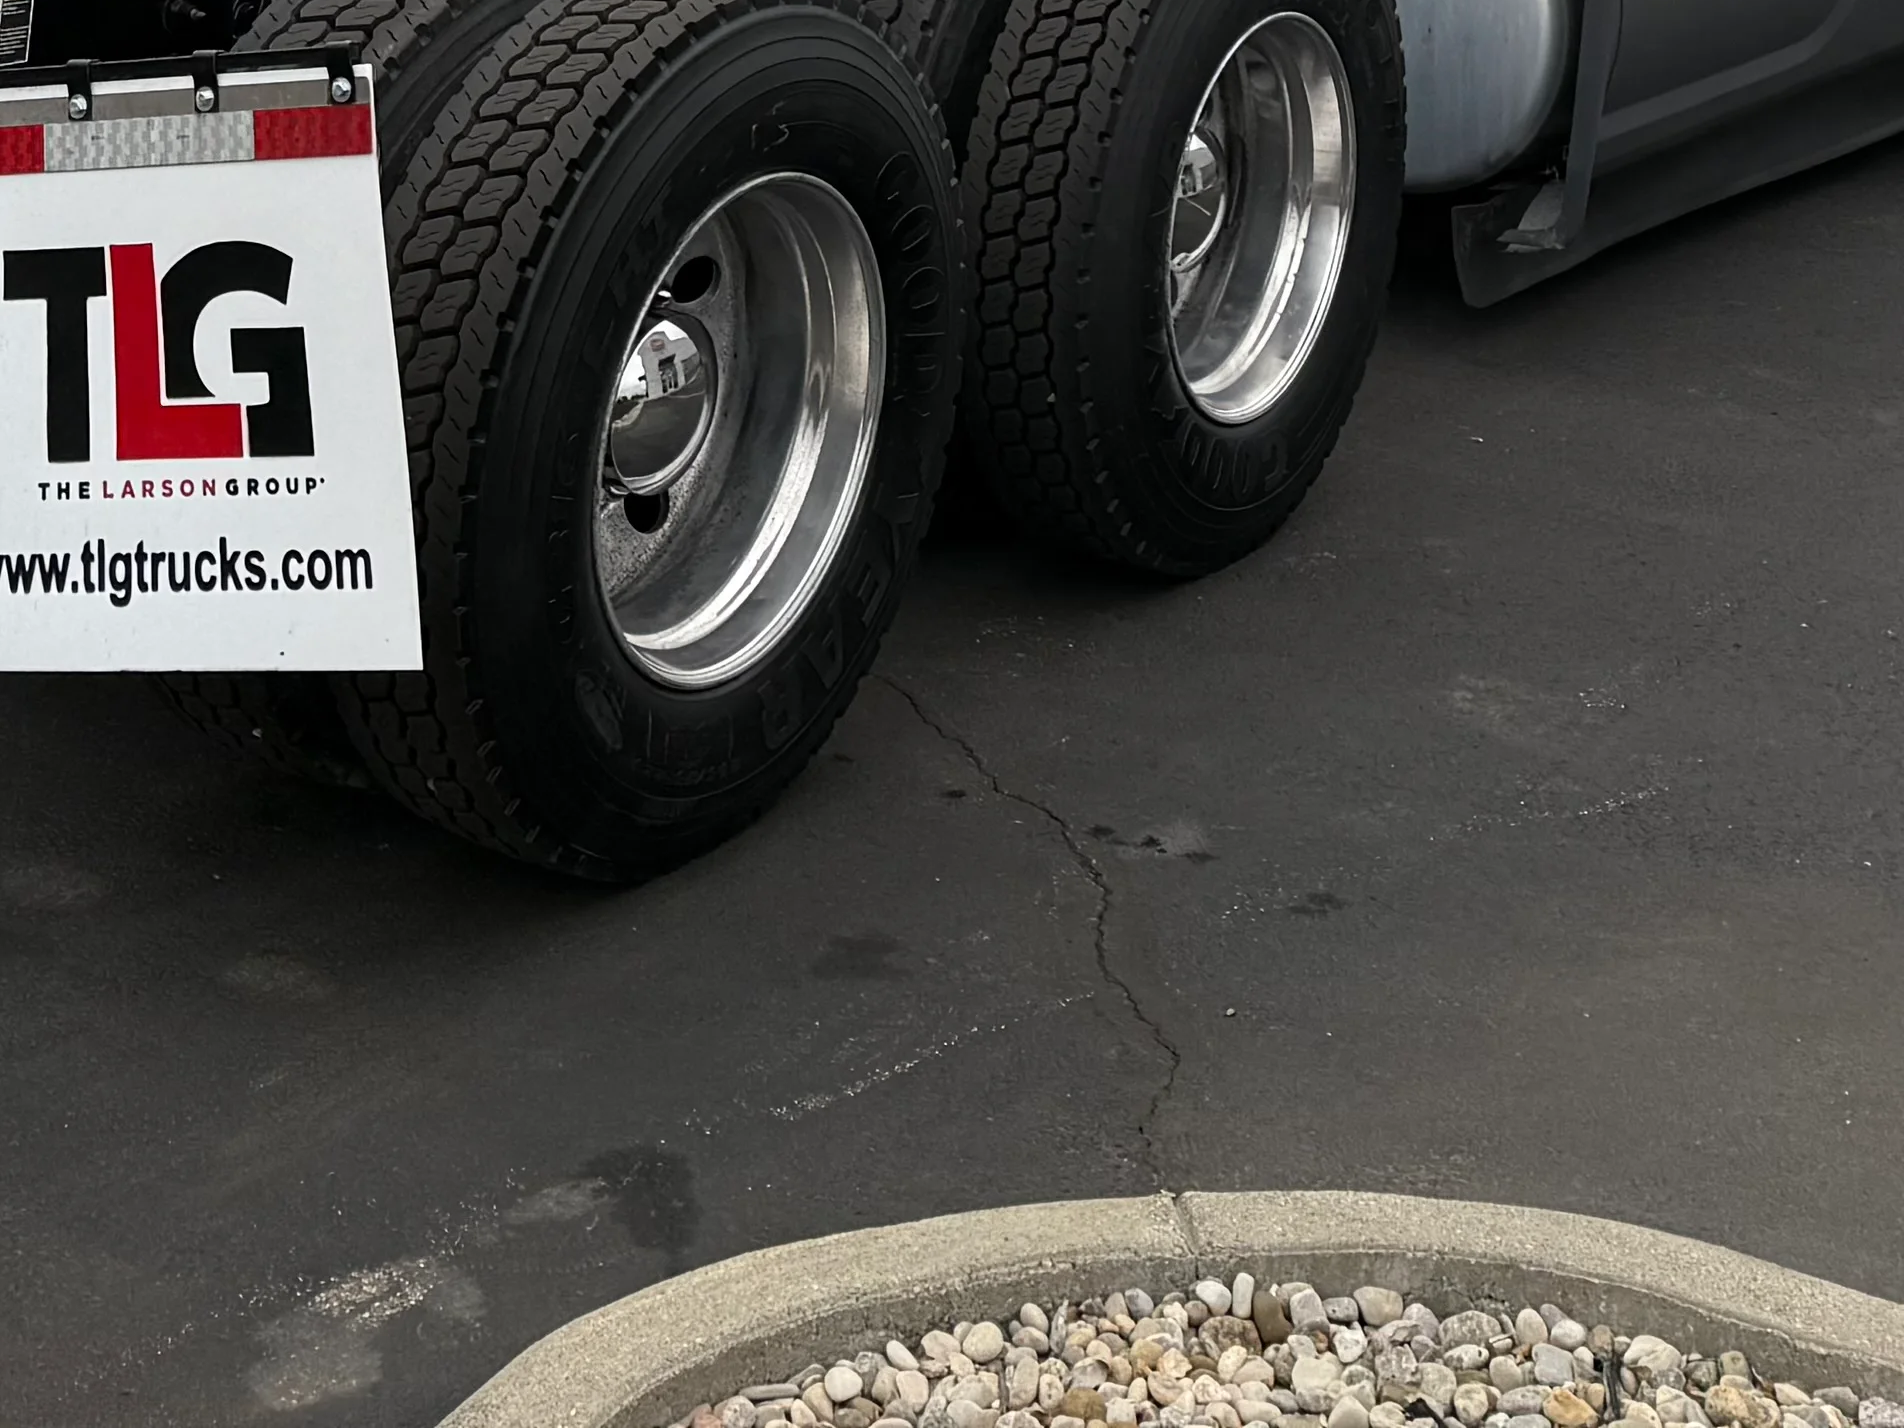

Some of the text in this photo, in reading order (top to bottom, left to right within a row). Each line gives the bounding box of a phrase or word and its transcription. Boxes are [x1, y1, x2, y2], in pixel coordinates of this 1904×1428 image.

[2, 240, 315, 463] TLG
[38, 477, 322, 501] THE LARSON GROUP
